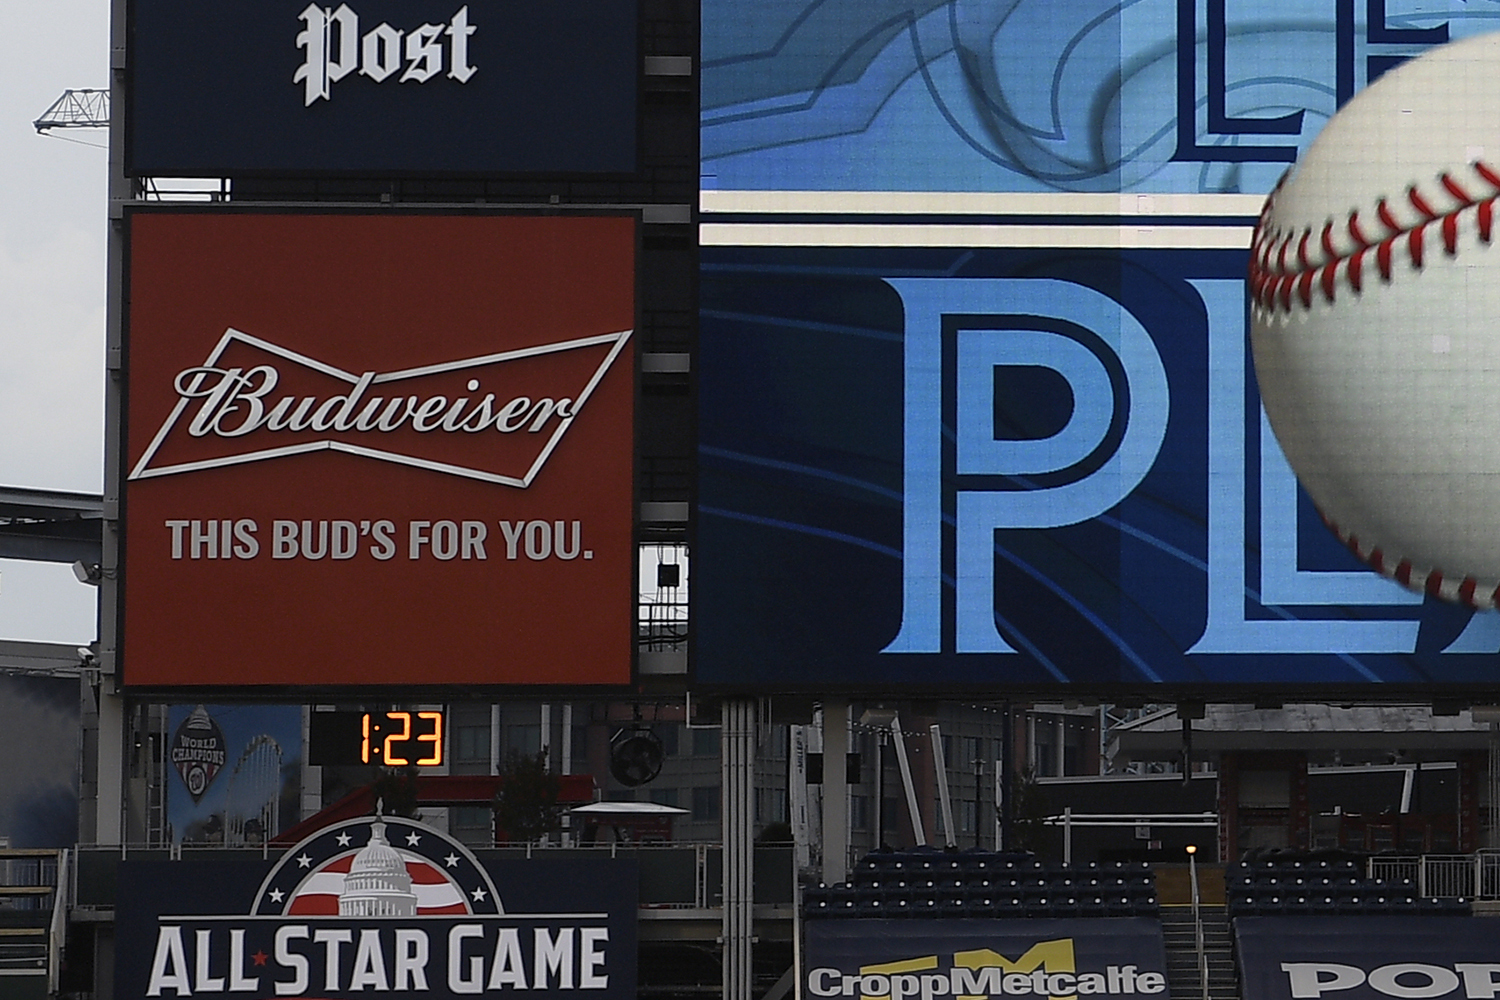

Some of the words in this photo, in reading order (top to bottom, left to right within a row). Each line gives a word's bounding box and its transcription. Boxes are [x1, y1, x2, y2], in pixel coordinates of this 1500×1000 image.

[293, 3, 478, 107] Post
[174, 365, 573, 437] Budweiser
[166, 519, 259, 560] THIS
[271, 520, 396, 560] BUD'S
[409, 521, 487, 560] FOR
[500, 521, 593, 560] YOU.
[172, 748, 225, 766] CHAMPIONS
[180, 734, 217, 749] WORLD
[360, 712, 443, 766] 1:23
[146, 925, 260, 997] ALL
[274, 924, 429, 996] STAR
[448, 923, 609, 995] GAME
